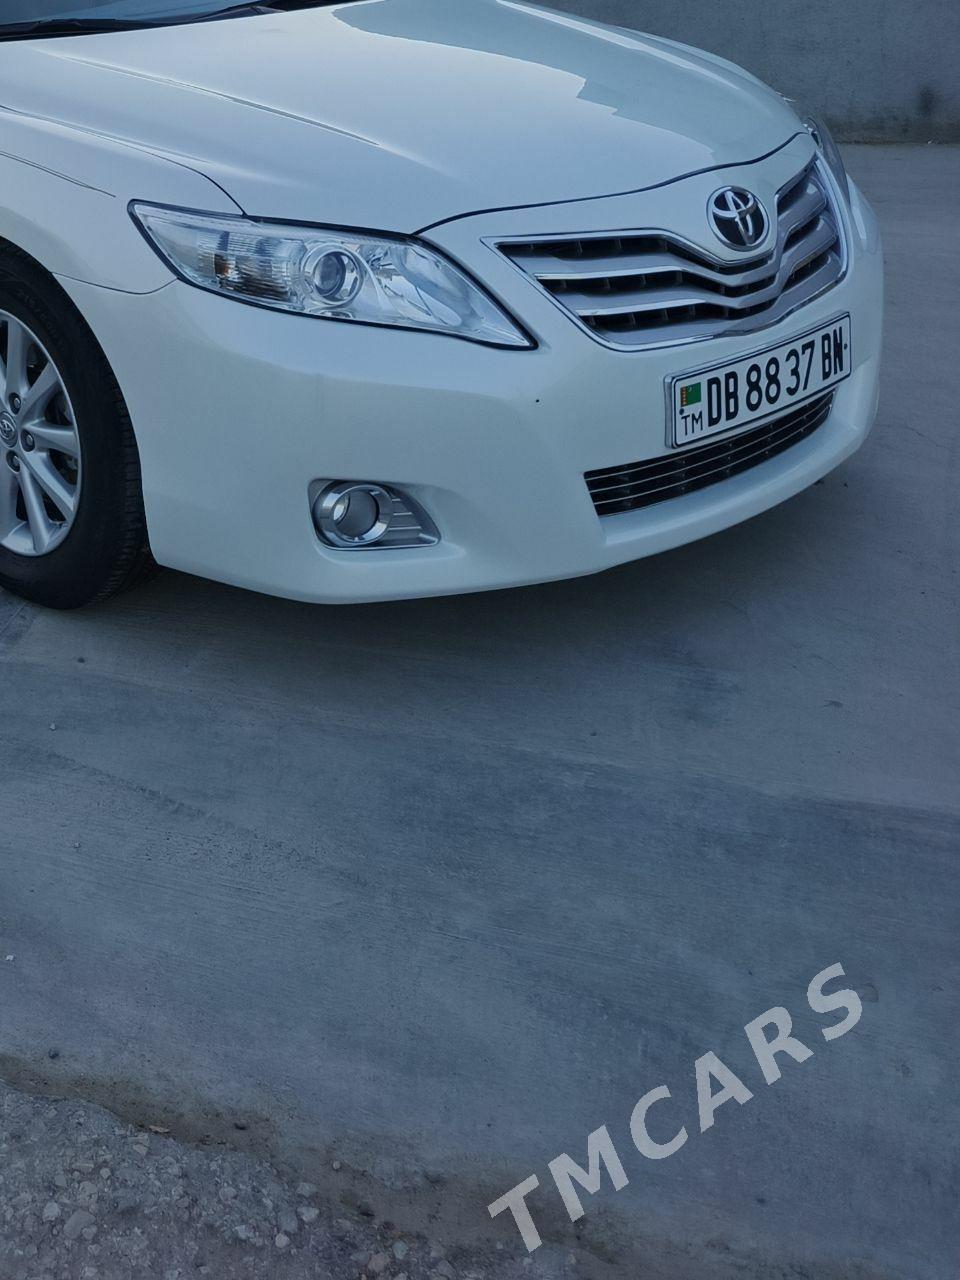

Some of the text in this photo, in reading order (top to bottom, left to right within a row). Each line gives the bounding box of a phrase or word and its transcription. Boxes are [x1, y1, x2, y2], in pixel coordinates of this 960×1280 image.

[706, 326, 844, 428] DB 8837 BN
[681, 410, 703, 437] TM
